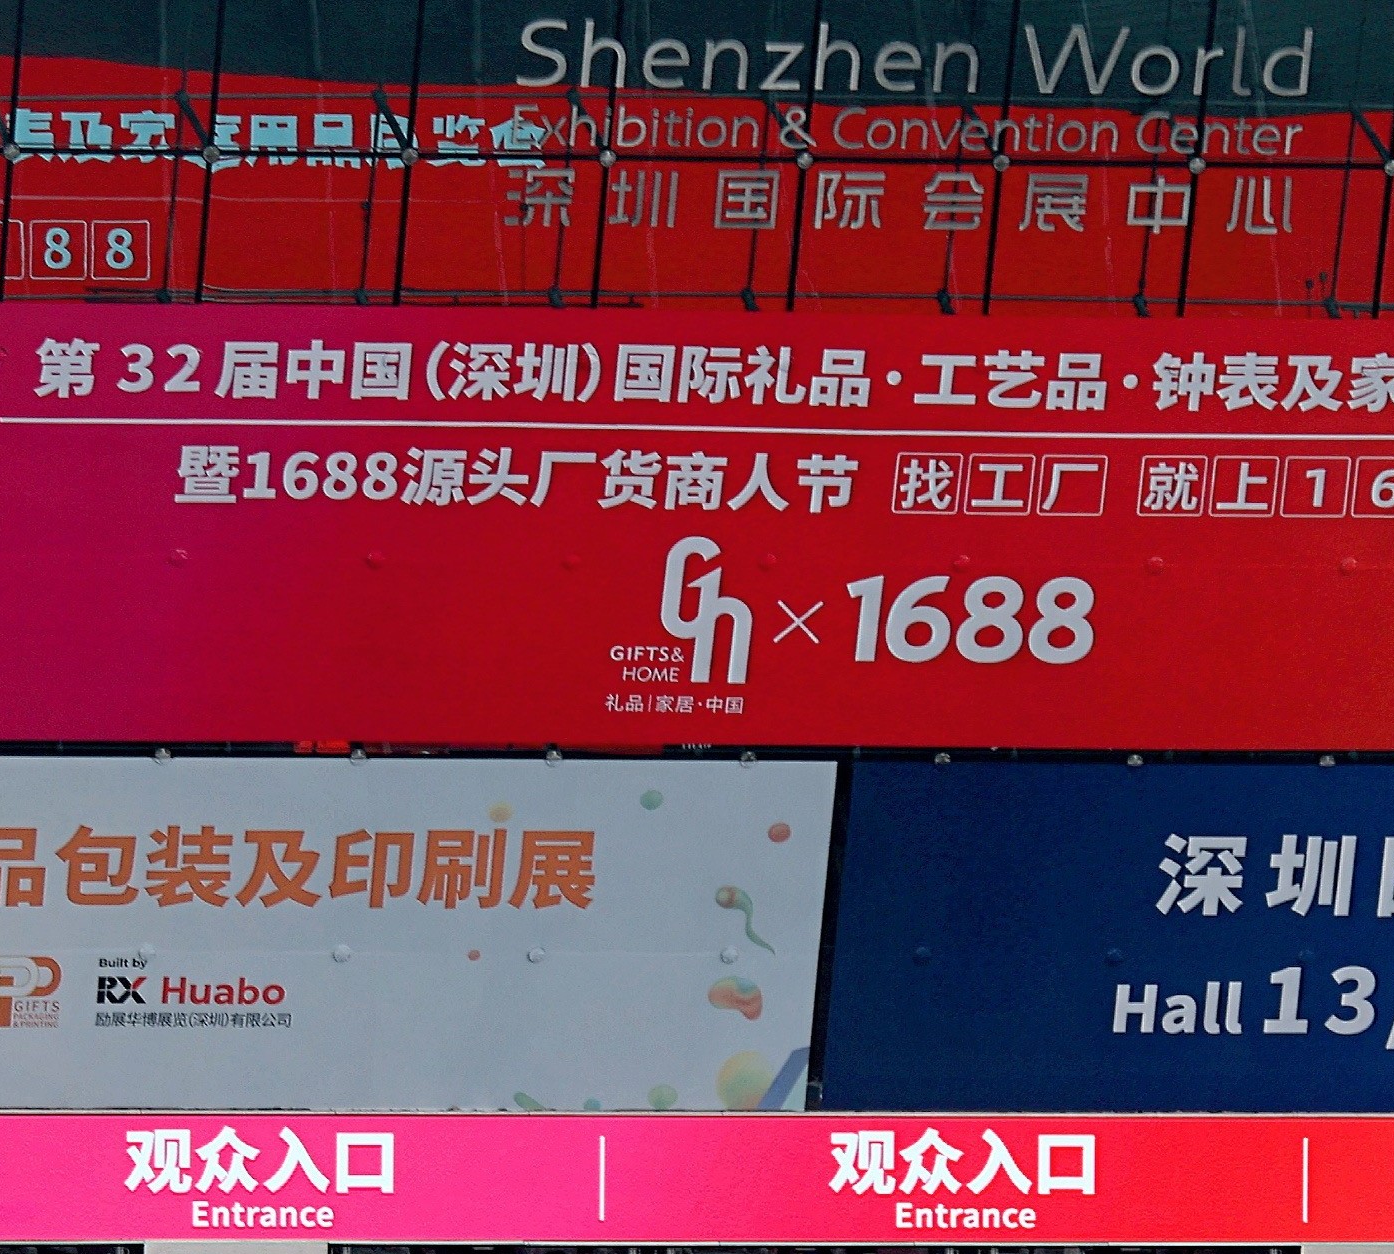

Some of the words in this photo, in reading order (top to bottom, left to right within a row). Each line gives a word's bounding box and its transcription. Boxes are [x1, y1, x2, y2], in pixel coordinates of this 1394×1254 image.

[516, 18, 978, 93] Shenzhen
[1024, 24, 1315, 98] World
[509, 104, 758, 149] Exhibition
[780, 105, 816, 149] &
[833, 107, 1118, 153] Convention
[1136, 110, 1303, 155] Center
[504, 168, 1293, 235] 深圳国际会展中心
[175, 443, 858, 514] 暨1688源头厂货商人节
[899, 457, 1098, 513] 找工厂
[846, 574, 1095, 665] 1688
[622, 666, 680, 683] HOME
[99, 958, 128, 968] Built
[131, 958, 148, 970] by
[14, 1000, 60, 1013] GIFTS
[97, 976, 148, 1004] RX
[161, 976, 287, 1005] Huabo
[1113, 981, 1244, 1035] Hall
[125, 1127, 396, 1195] 观众入口
[828, 1128, 1097, 1197] 观众入口
[191, 1200, 335, 1229] Entrance
[895, 1201, 1038, 1230] Entrance
